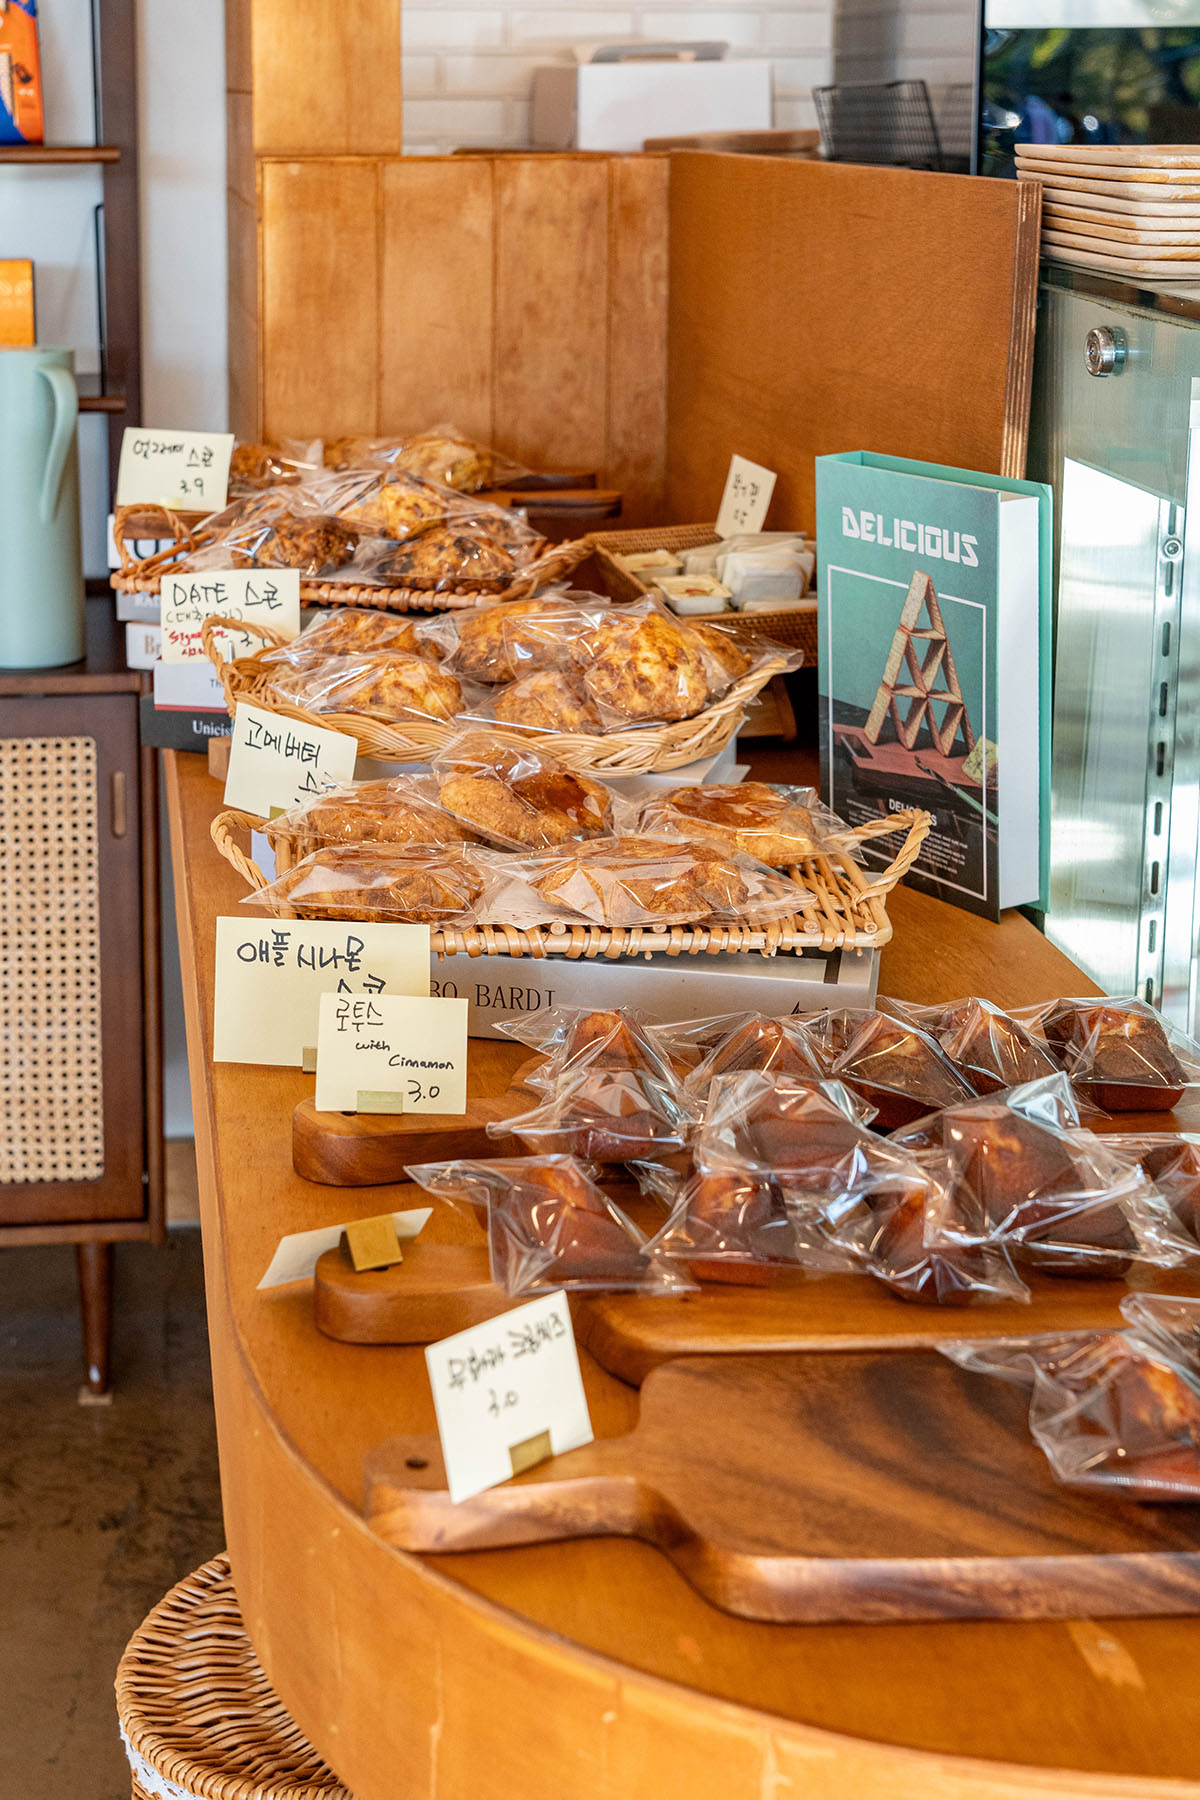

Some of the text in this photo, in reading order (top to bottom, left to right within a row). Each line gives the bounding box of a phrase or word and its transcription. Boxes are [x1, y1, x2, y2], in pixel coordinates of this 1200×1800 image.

[186, 446, 214, 468] 스콘
[842, 506, 979, 567] DELICIOUS
[173, 582, 228, 606] DATE
[245, 581, 283, 609] 스콘
[244, 717, 321, 769] 고메버터
[475, 983, 556, 1012] BARDI
[335, 998, 384, 1033] 로투스
[355, 1039, 391, 1052] with
[388, 1053, 455, 1071] Cinnamon
[407, 1079, 440, 1103] 3.0
